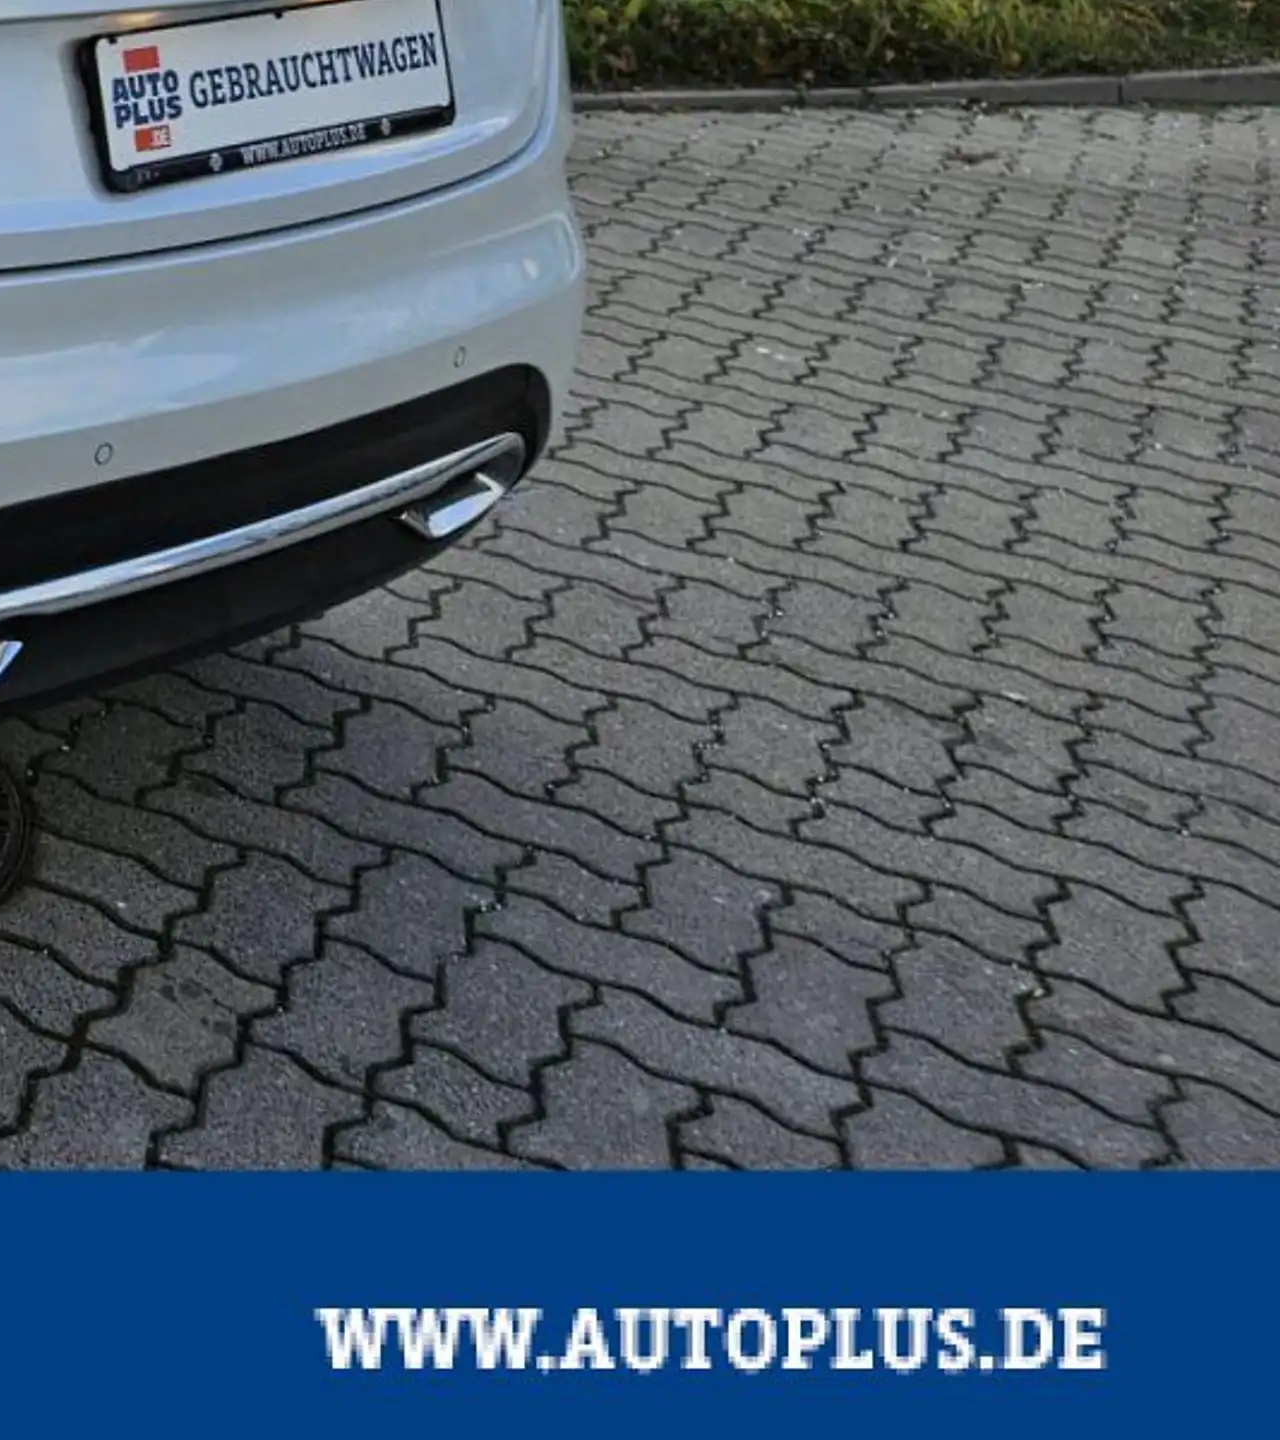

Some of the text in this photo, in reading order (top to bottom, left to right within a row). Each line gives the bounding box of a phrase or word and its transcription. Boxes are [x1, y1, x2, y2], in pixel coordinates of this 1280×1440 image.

[112, 69, 180, 104] AUTO
[189, 32, 438, 109] GEBRAUCHTWAGEN
[113, 96, 183, 130] PLUS
[242, 122, 367, 165] WWW.AUTOPLUS.DE
